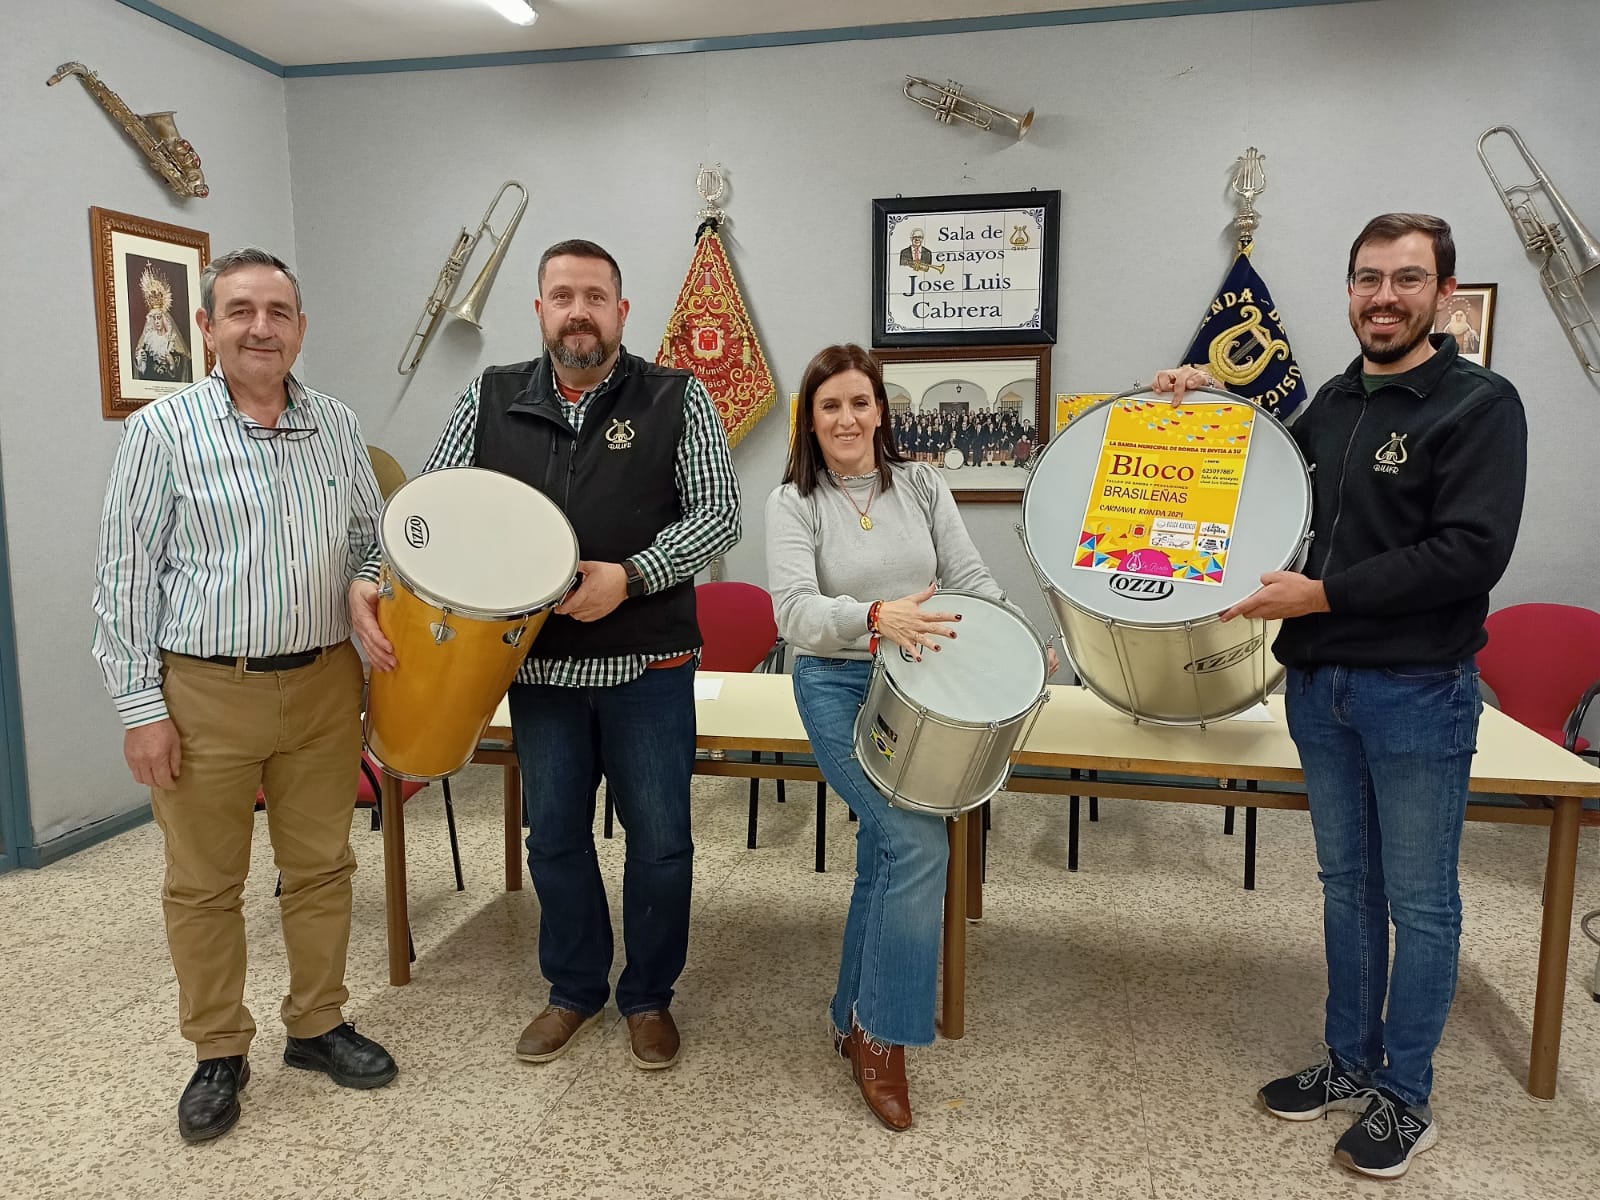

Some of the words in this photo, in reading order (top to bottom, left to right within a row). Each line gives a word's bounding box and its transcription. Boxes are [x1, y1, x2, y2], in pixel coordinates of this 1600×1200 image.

[938, 226, 975, 241] Sala
[981, 225, 1003, 239] de
[936, 249, 1005, 264] ensayos
[903, 275, 955, 297] Jose
[963, 272, 1011, 291] Luis
[912, 301, 1002, 319] Cabrera
[678, 343, 697, 371] Banda
[697, 353, 736, 376] Municipal
[731, 343, 739, 354] de
[1138, 443, 1169, 451] MUNICIPAL
[1109, 454, 1194, 482] Bloco
[1103, 485, 1188, 503] BRASILEÑAS
[1099, 504, 1136, 514] CARNAVAL
[1138, 508, 1166, 517] RONDA
[1196, 639, 1260, 672] IZZO
